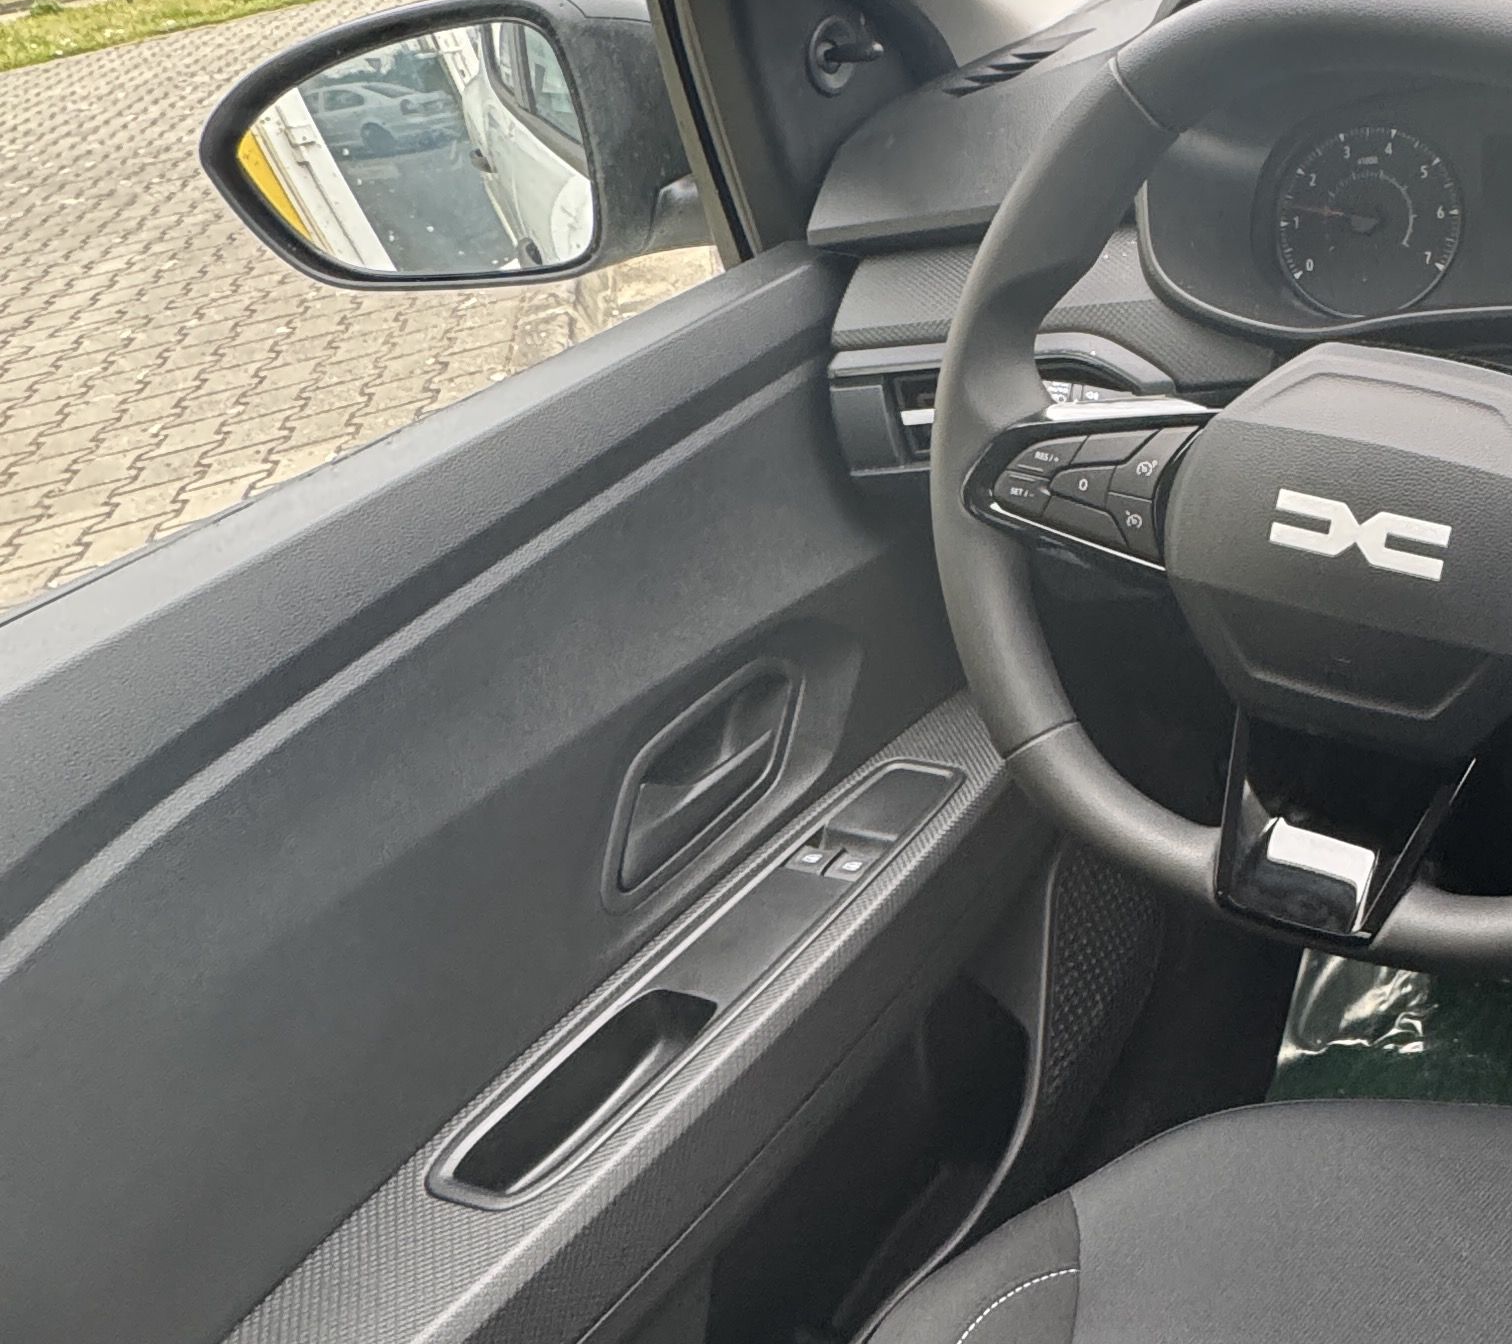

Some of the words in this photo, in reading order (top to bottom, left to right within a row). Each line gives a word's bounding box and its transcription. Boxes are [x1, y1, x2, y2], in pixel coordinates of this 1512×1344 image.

[1343, 145, 1351, 159] 3
[1384, 142, 1393, 156] 4
[1420, 165, 1428, 179] 5
[1308, 173, 1317, 187] 2
[1436, 205, 1445, 219] 6
[1305, 258, 1314, 272] 0
[1423, 251, 1432, 265] 7
